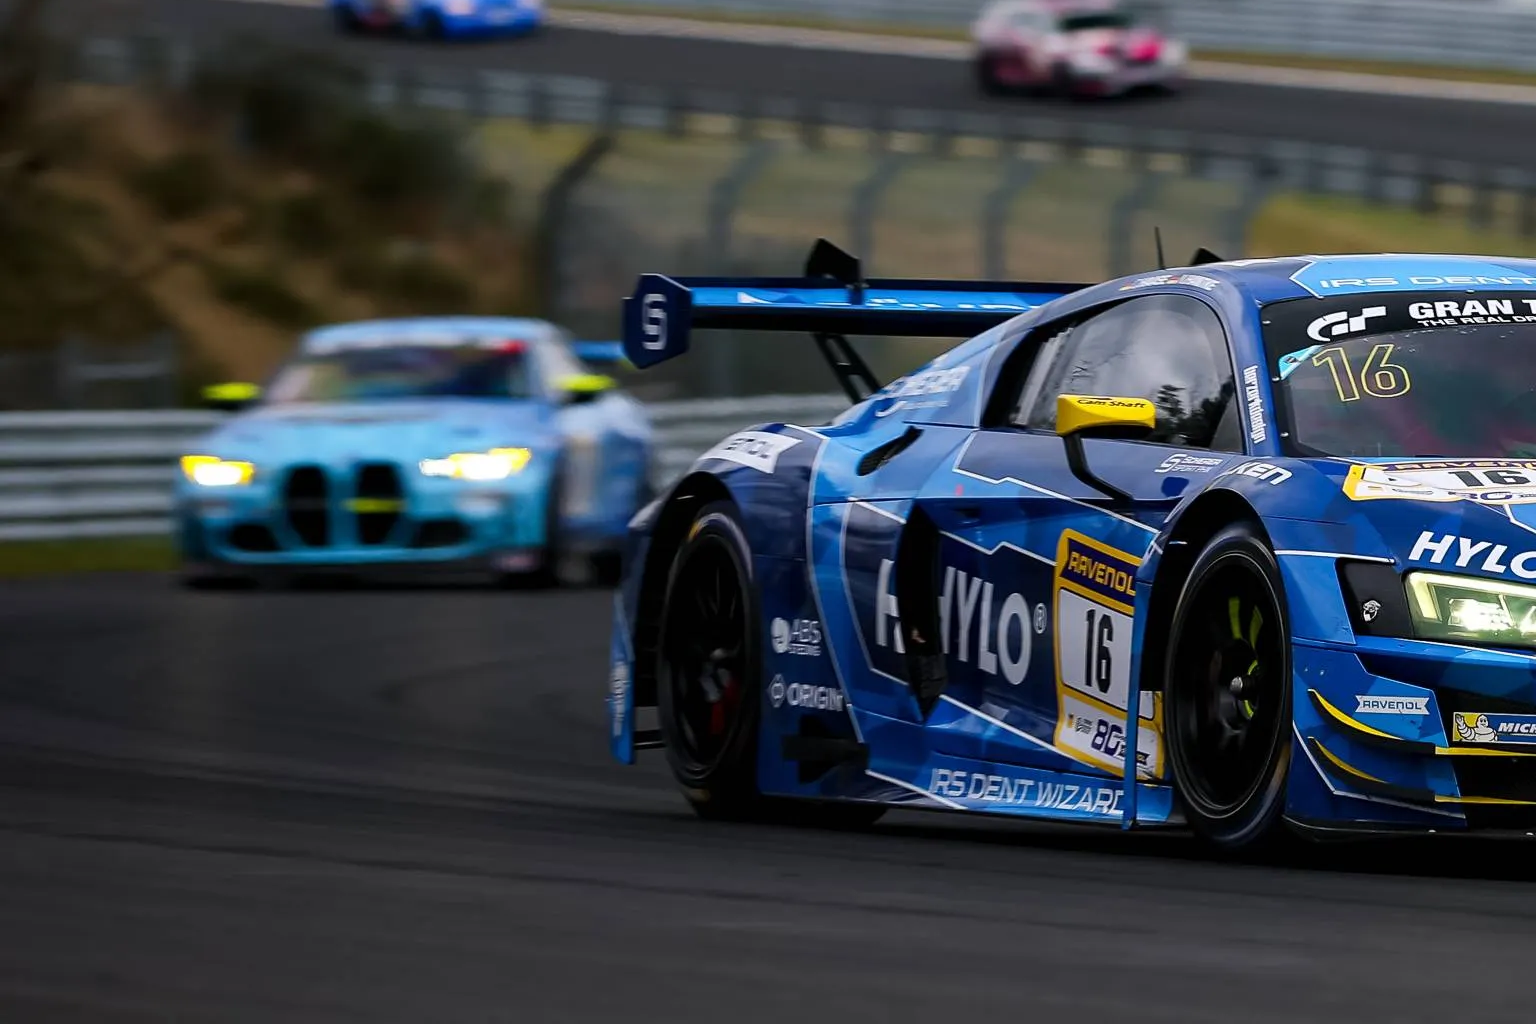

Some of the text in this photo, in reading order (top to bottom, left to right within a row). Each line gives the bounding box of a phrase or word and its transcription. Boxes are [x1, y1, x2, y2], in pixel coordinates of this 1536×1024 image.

[1320, 276, 1400, 288] IRS
[1408, 299, 1514, 320] GRAN
[1417, 317, 1459, 327] THE
[1459, 316, 1512, 326] REAL
[1312, 344, 1411, 402] 16
[1108, 400, 1147, 408] Shaft
[1228, 462, 1293, 485] KEN
[1448, 470, 1531, 487] 16
[1067, 551, 1137, 597] RAVENOL
[1085, 608, 1113, 694] 16
[1362, 699, 1423, 712] RAVENOL
[928, 768, 967, 797] IRS
[967, 773, 1034, 804] DENT
